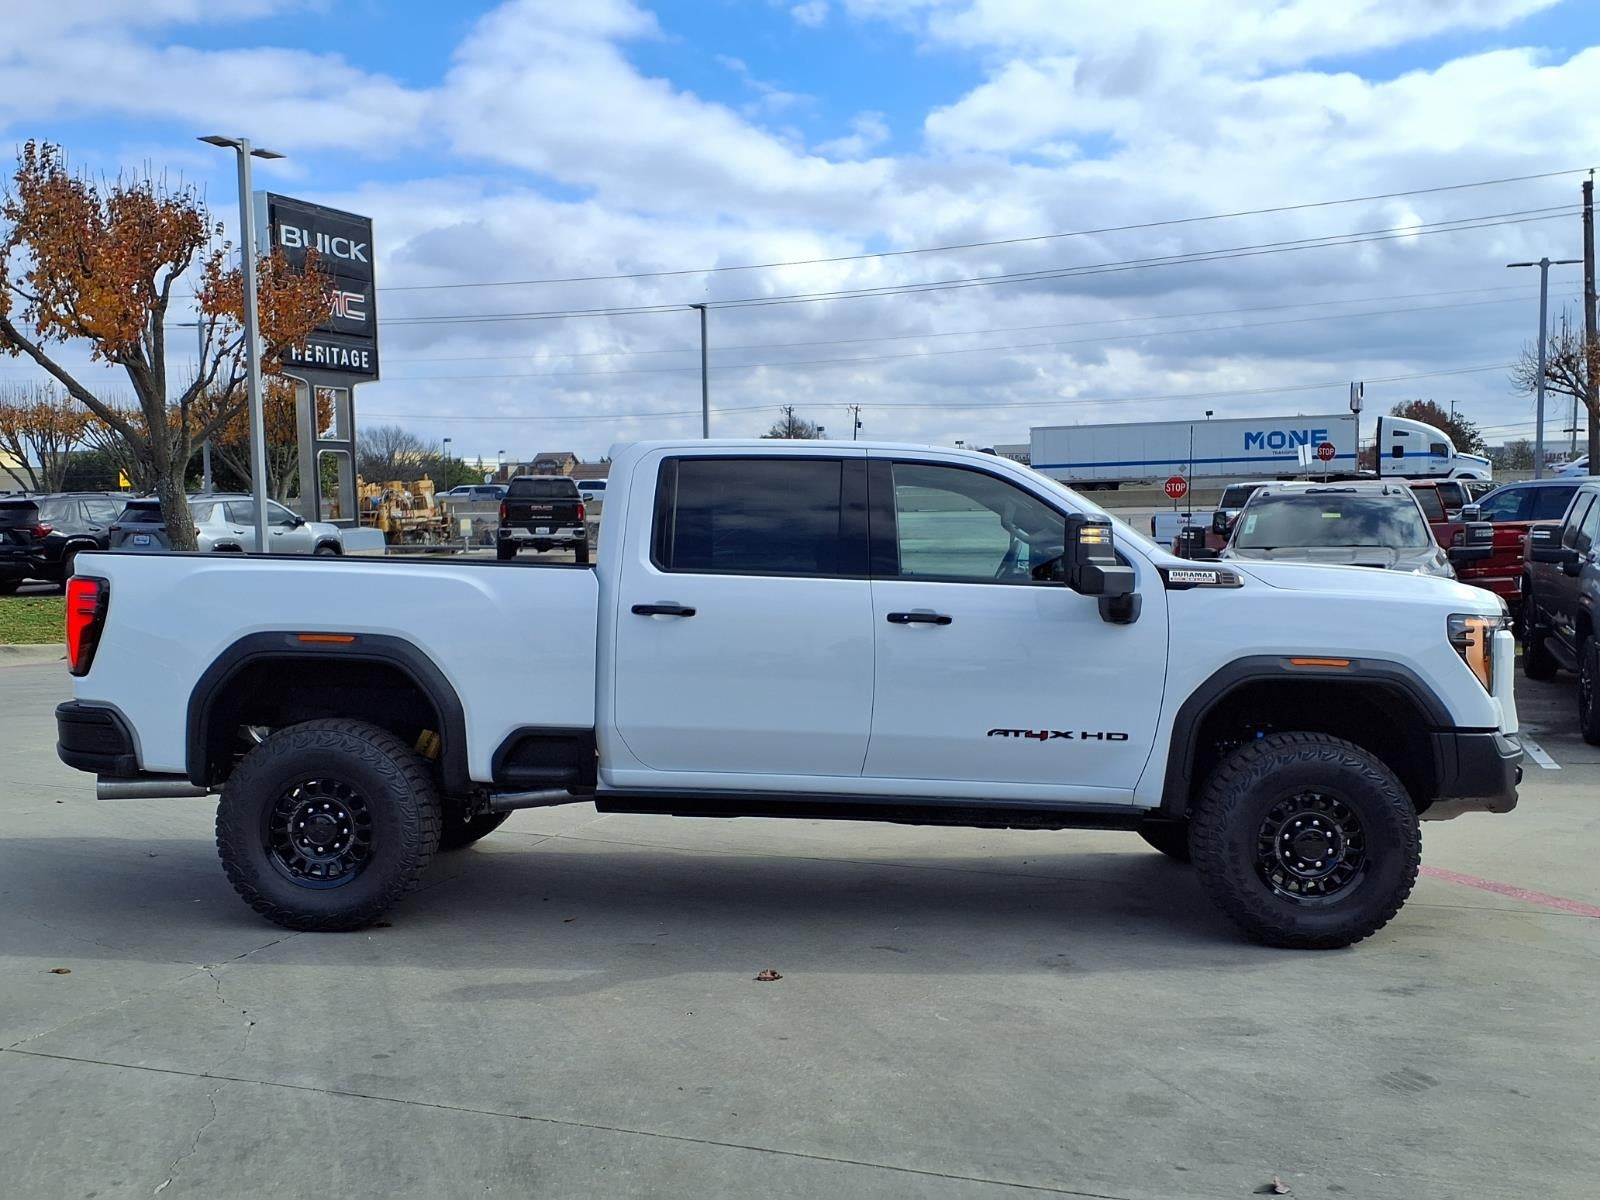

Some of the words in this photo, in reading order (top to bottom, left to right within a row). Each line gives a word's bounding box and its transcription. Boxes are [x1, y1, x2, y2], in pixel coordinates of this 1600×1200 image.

[280, 224, 368, 263] BUICK
[291, 342, 369, 368] HERITAGE
[1244, 429, 1328, 448] MONE
[1318, 447, 1335, 456] STOP
[1166, 483, 1186, 492] STOP
[987, 729, 1074, 741] AT4X
[1081, 731, 1128, 741] HD
